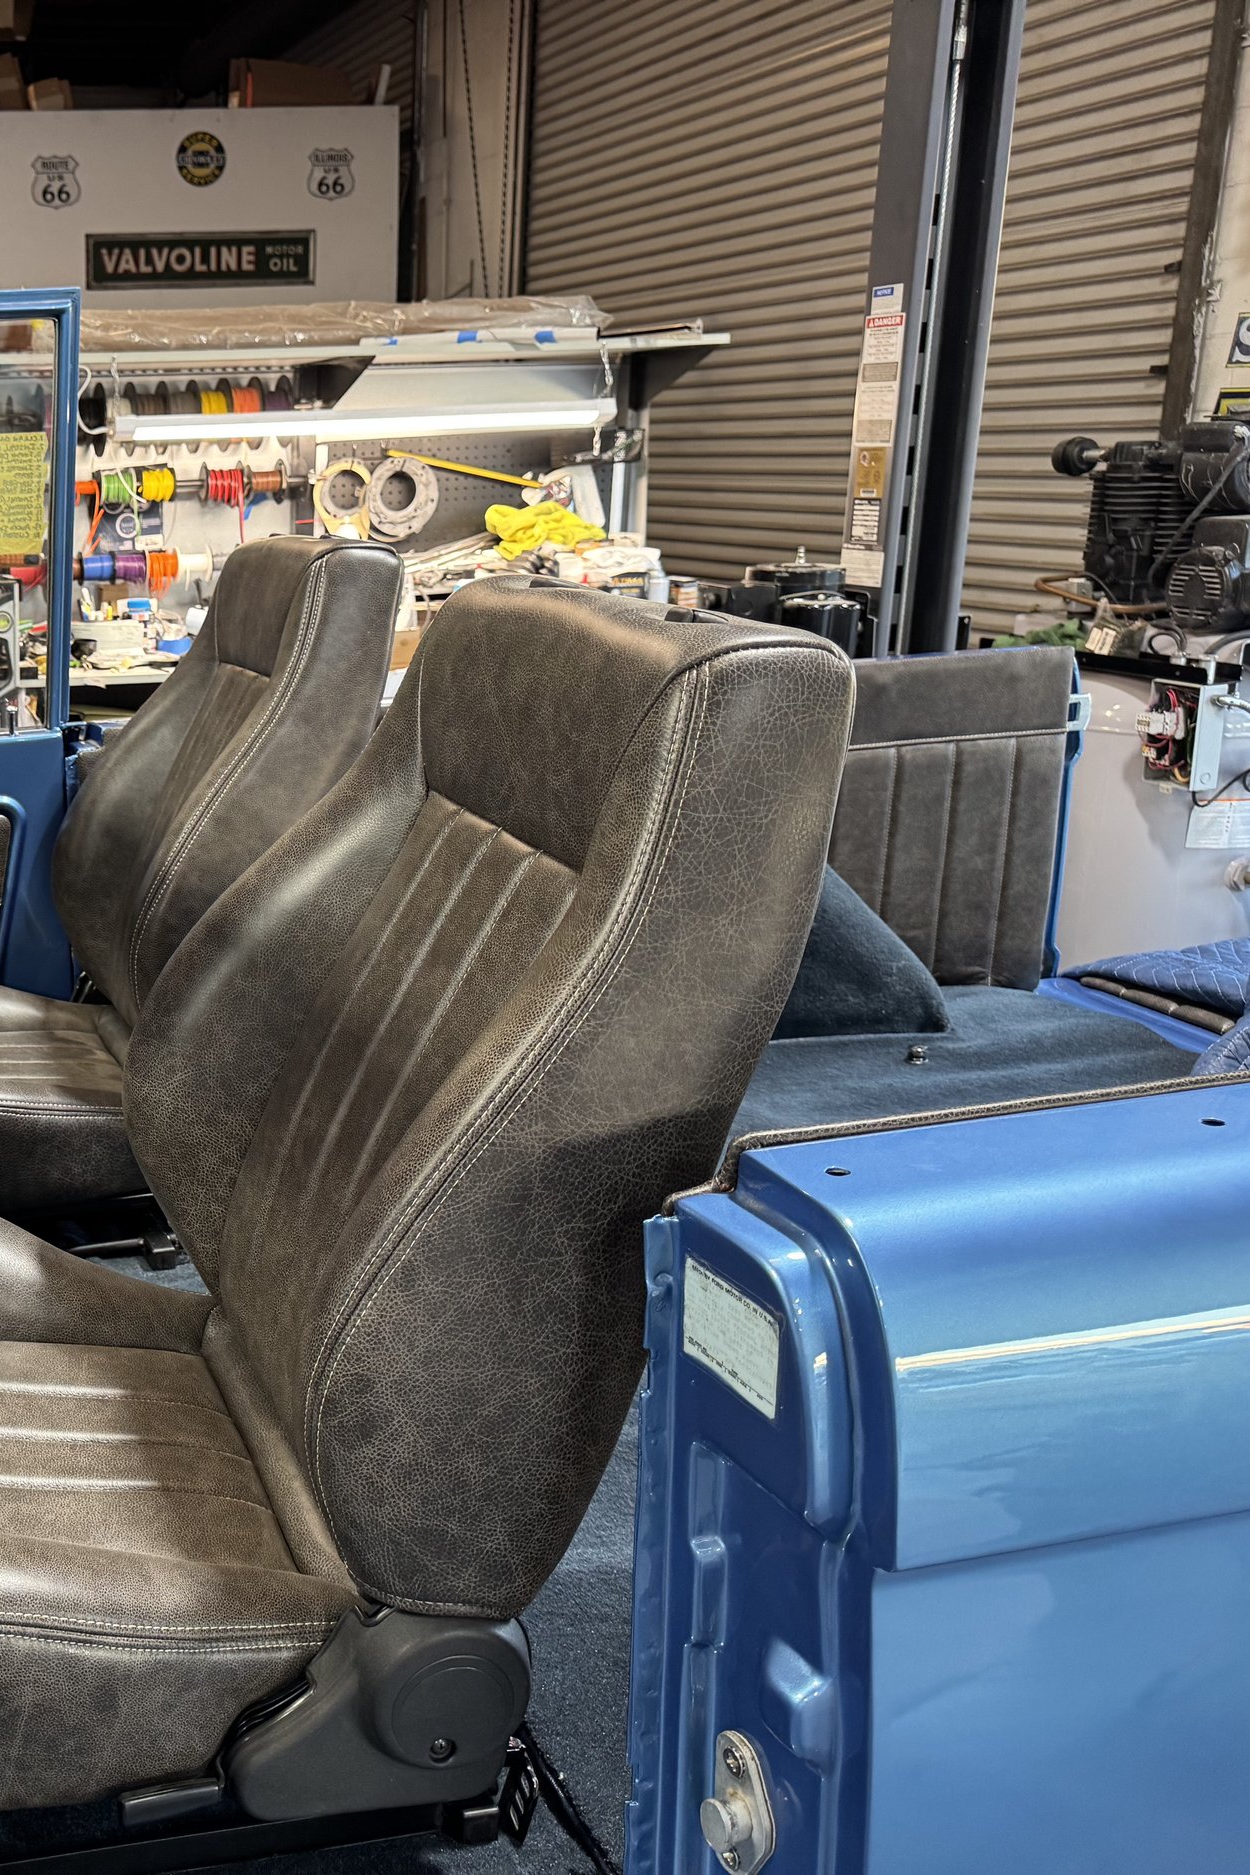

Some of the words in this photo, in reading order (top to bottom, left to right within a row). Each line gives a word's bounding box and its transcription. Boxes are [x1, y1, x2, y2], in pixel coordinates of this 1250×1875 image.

[42, 161, 69, 170] ROUTE
[43, 184, 70, 203] 66
[318, 176, 345, 195] 66
[101, 246, 257, 274] VALVOLINE
[265, 245, 304, 255] MOTOR
[269, 257, 299, 272] OIL
[875, 317, 901, 327] DANGER
[712, 1278, 725, 1291] FORD
[725, 1287, 743, 1304] MOTOR
